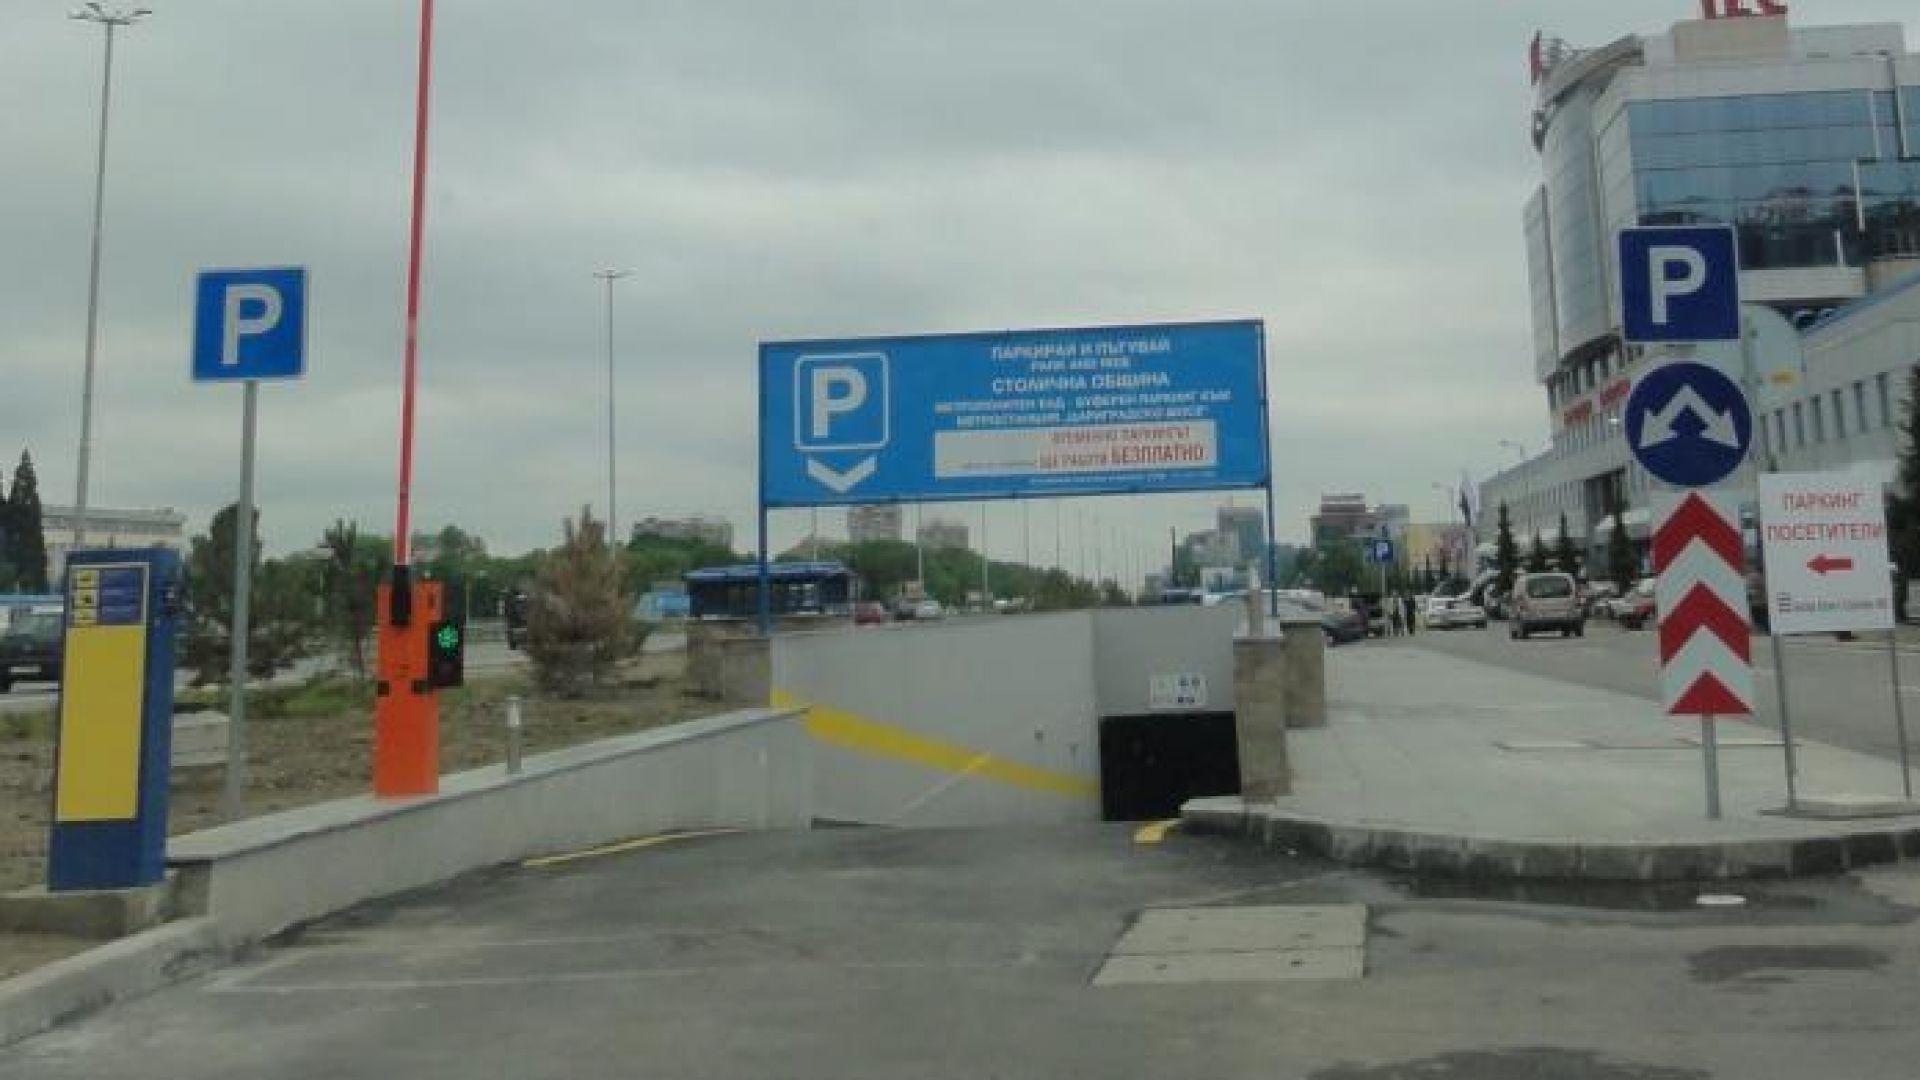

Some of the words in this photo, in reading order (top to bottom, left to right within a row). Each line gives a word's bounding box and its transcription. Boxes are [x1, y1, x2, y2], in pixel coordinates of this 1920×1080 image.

[1648, 245, 1706, 325] P
[222, 283, 283, 365] P
[812, 368, 867, 439] P
[1110, 443, 1204, 464] БЕЗПЛАТНО
[1783, 492, 1866, 511] ПАРКИНГ
[1766, 522, 1885, 542] ПОСЕТИТЕЛИ
